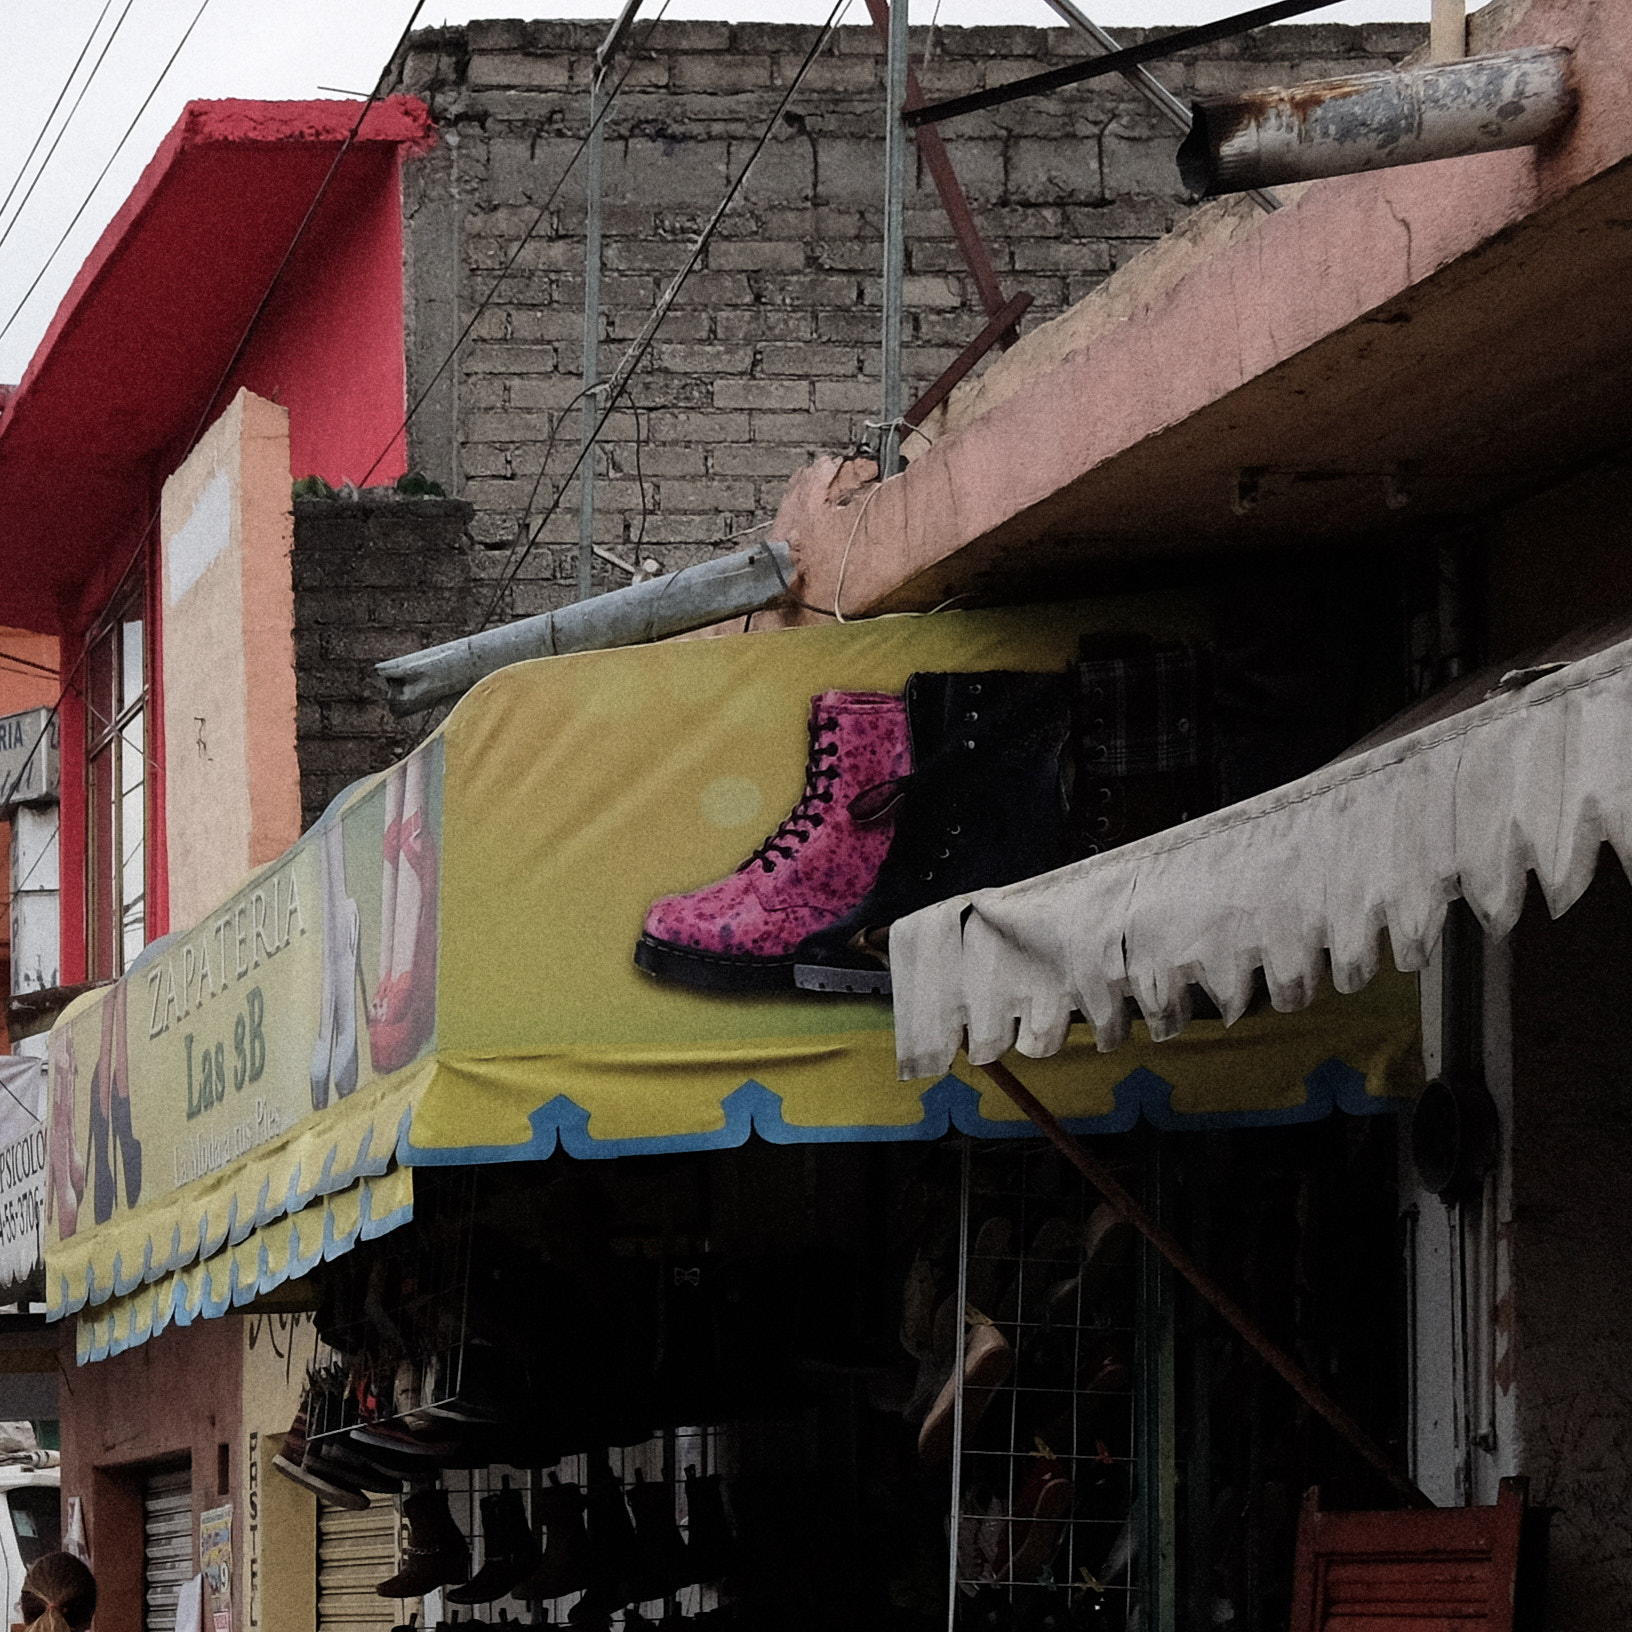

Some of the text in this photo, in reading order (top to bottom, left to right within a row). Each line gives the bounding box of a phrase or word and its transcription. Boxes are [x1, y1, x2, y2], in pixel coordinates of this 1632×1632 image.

[147, 867, 307, 1041] ZAPATERIA
[184, 1032, 226, 1122] Las
[0, 1126, 48, 1194] PSICOLO
